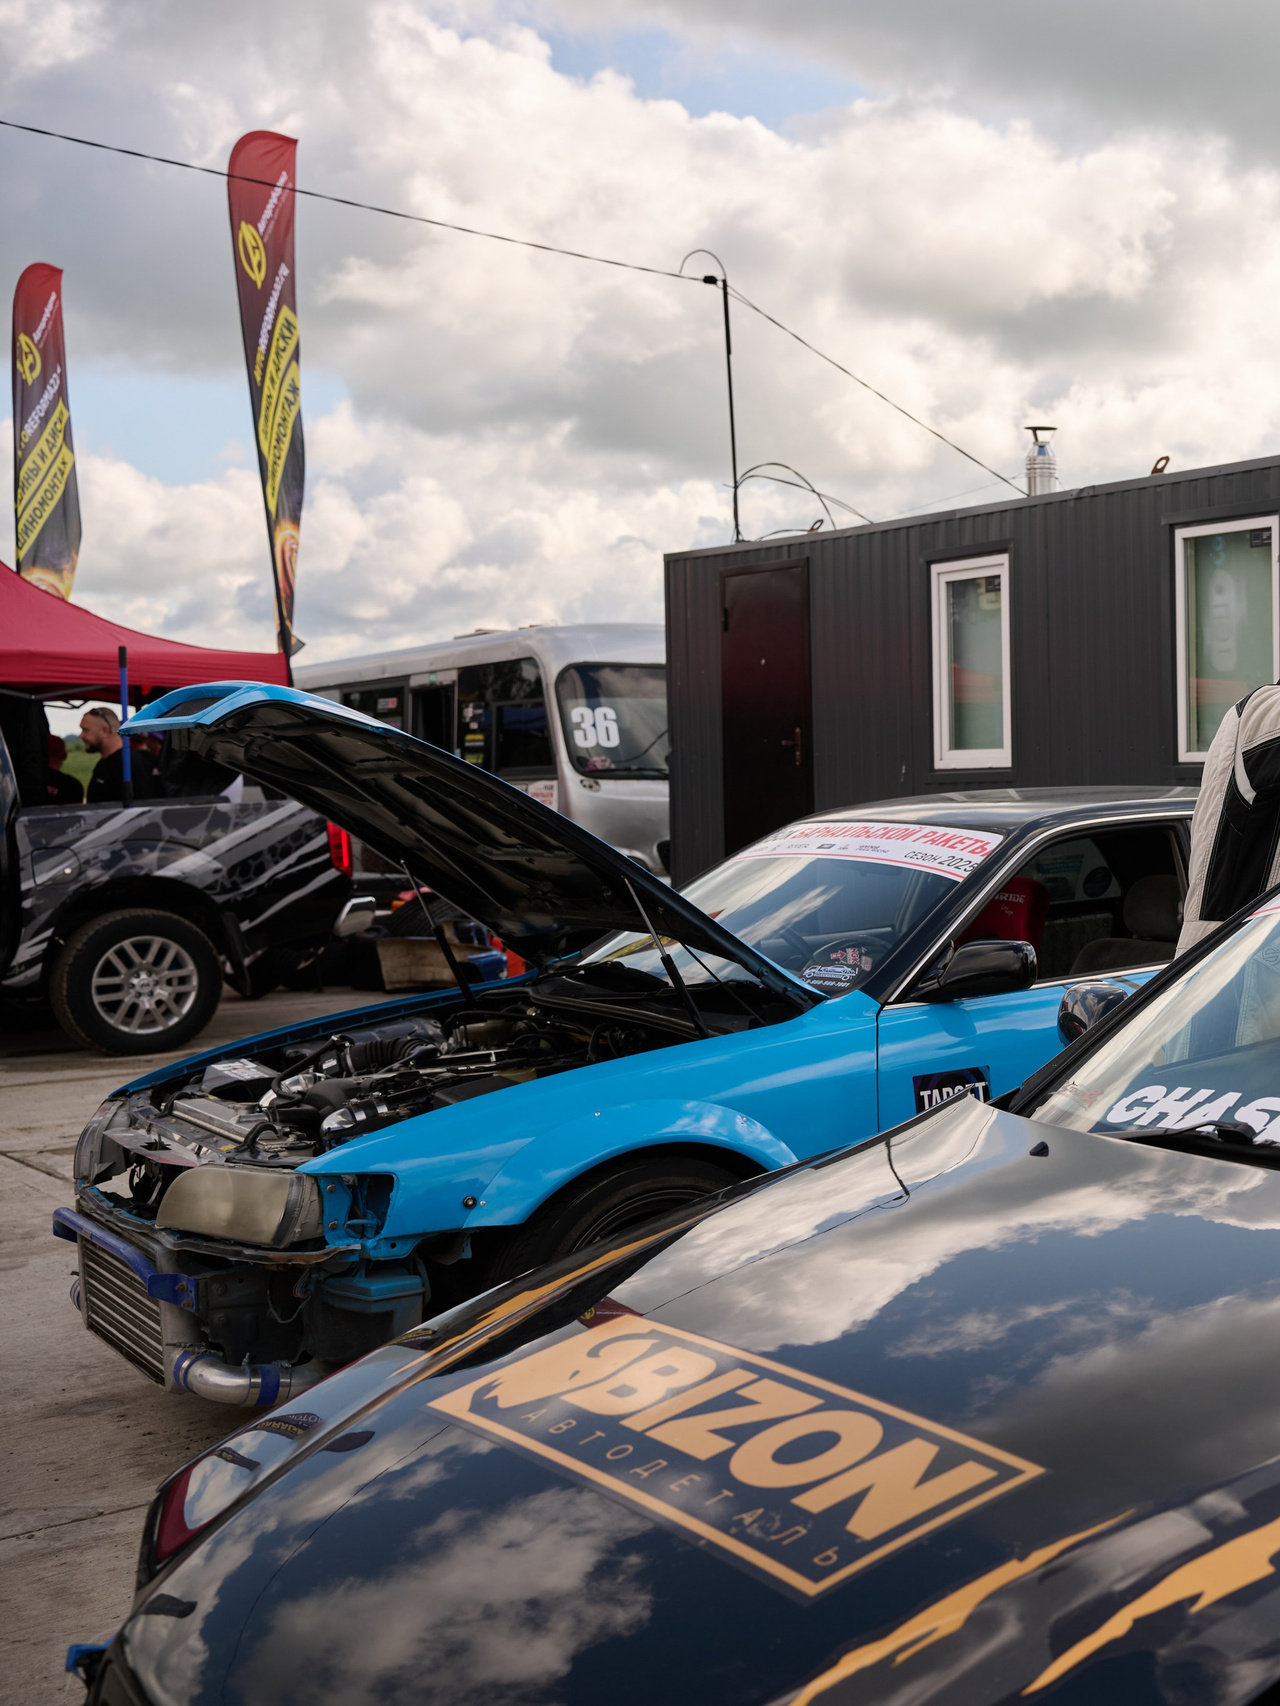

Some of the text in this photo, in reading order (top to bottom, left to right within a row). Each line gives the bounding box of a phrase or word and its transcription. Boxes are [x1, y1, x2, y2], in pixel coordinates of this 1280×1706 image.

[570, 706, 620, 748] 36
[904, 850, 978, 873] СЕЗОН 2025
[521, 1406, 841, 1568] АВТОДЕТАЛЬ
[559, 1345, 999, 1541] BIZON
